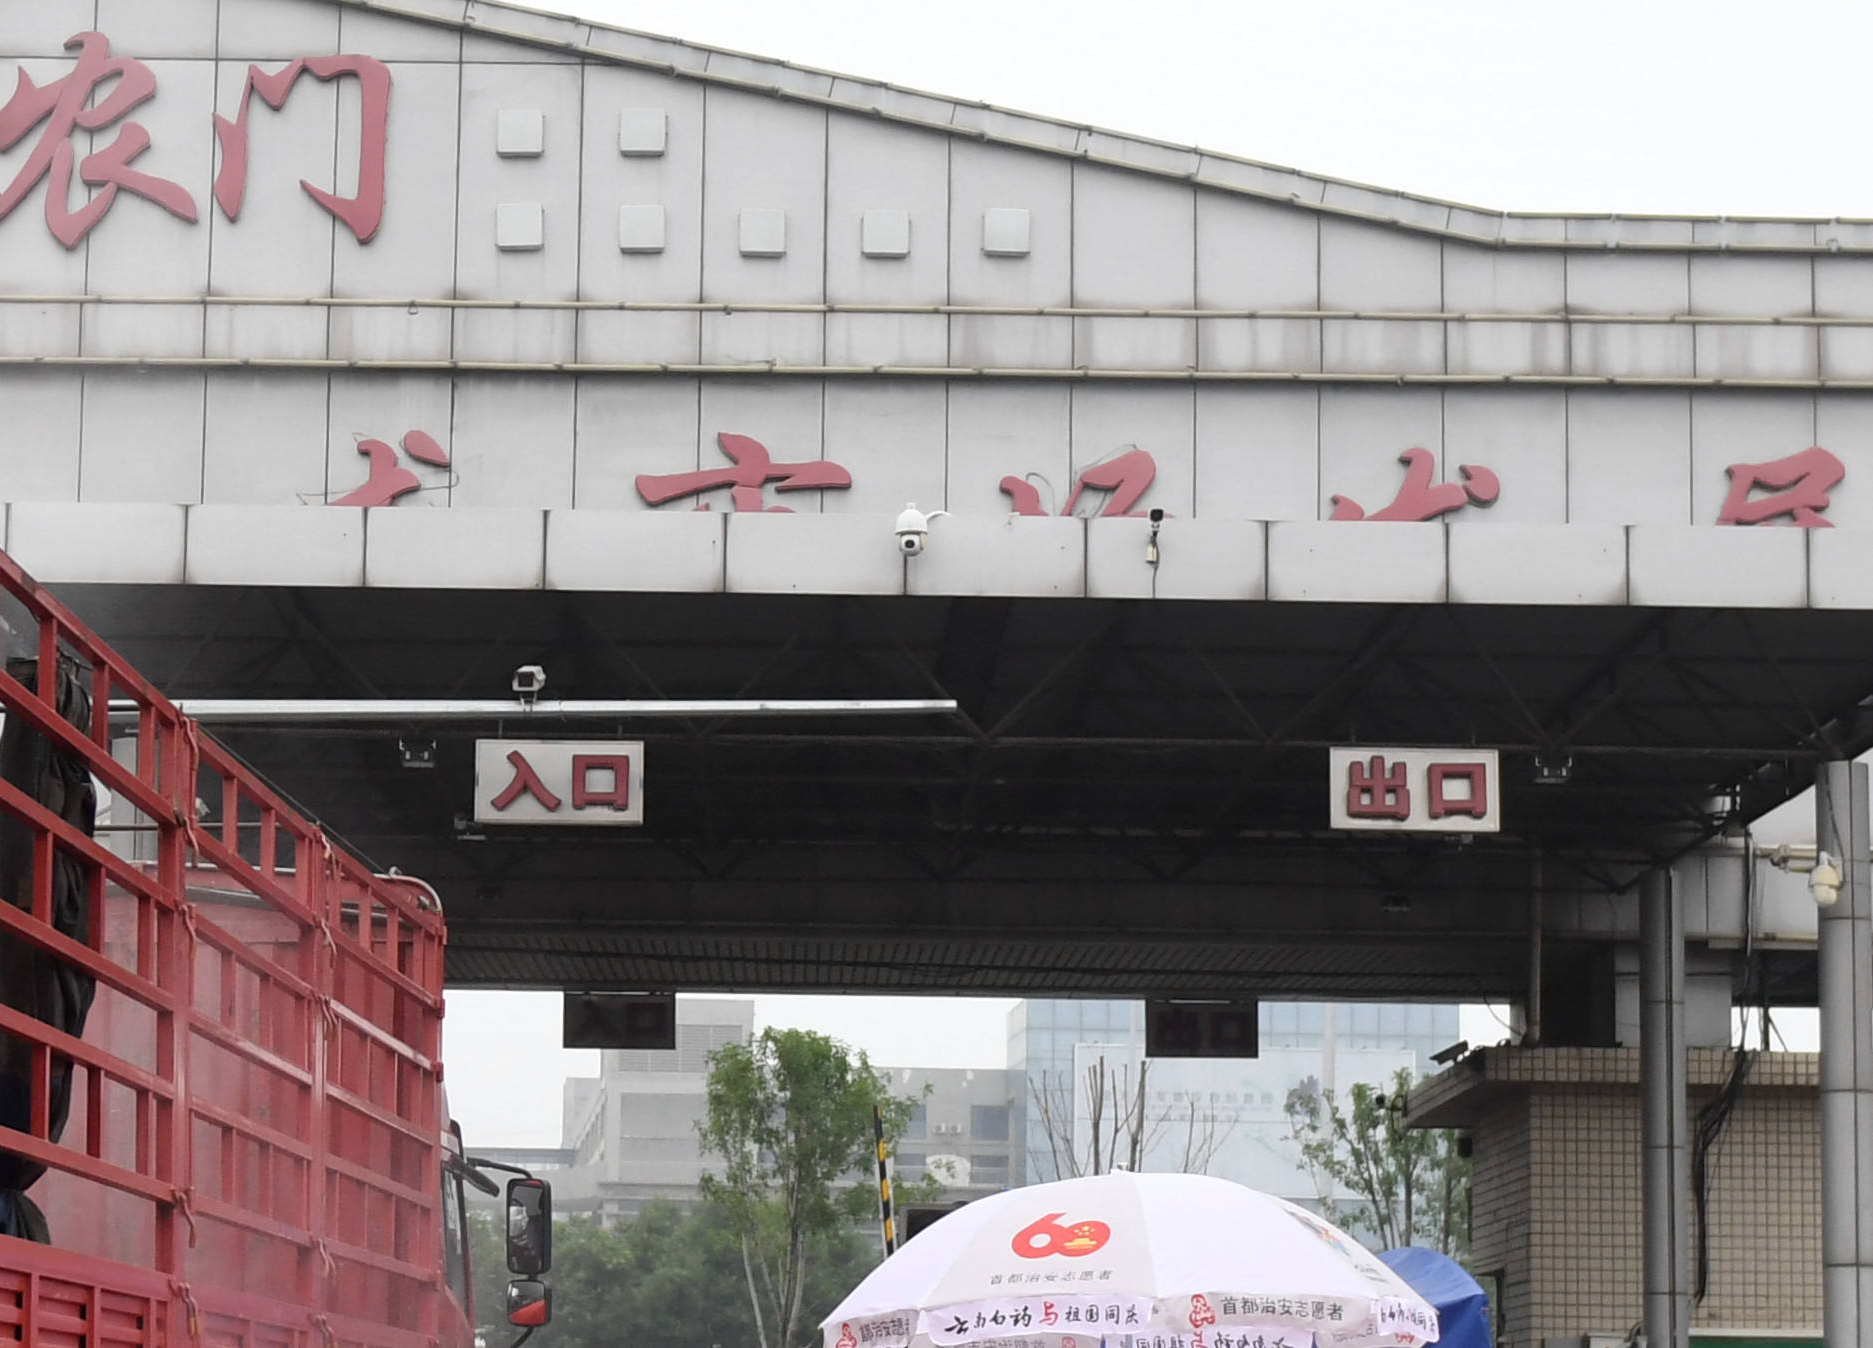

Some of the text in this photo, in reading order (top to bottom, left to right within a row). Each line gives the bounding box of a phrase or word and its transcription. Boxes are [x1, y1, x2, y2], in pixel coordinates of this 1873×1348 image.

[490, 750, 630, 812] 入口
[1347, 755, 1488, 821] 出口
[990, 1269, 1113, 1286] 首都治安志愿者
[1220, 1297, 1344, 1321] 首都治安志愿者
